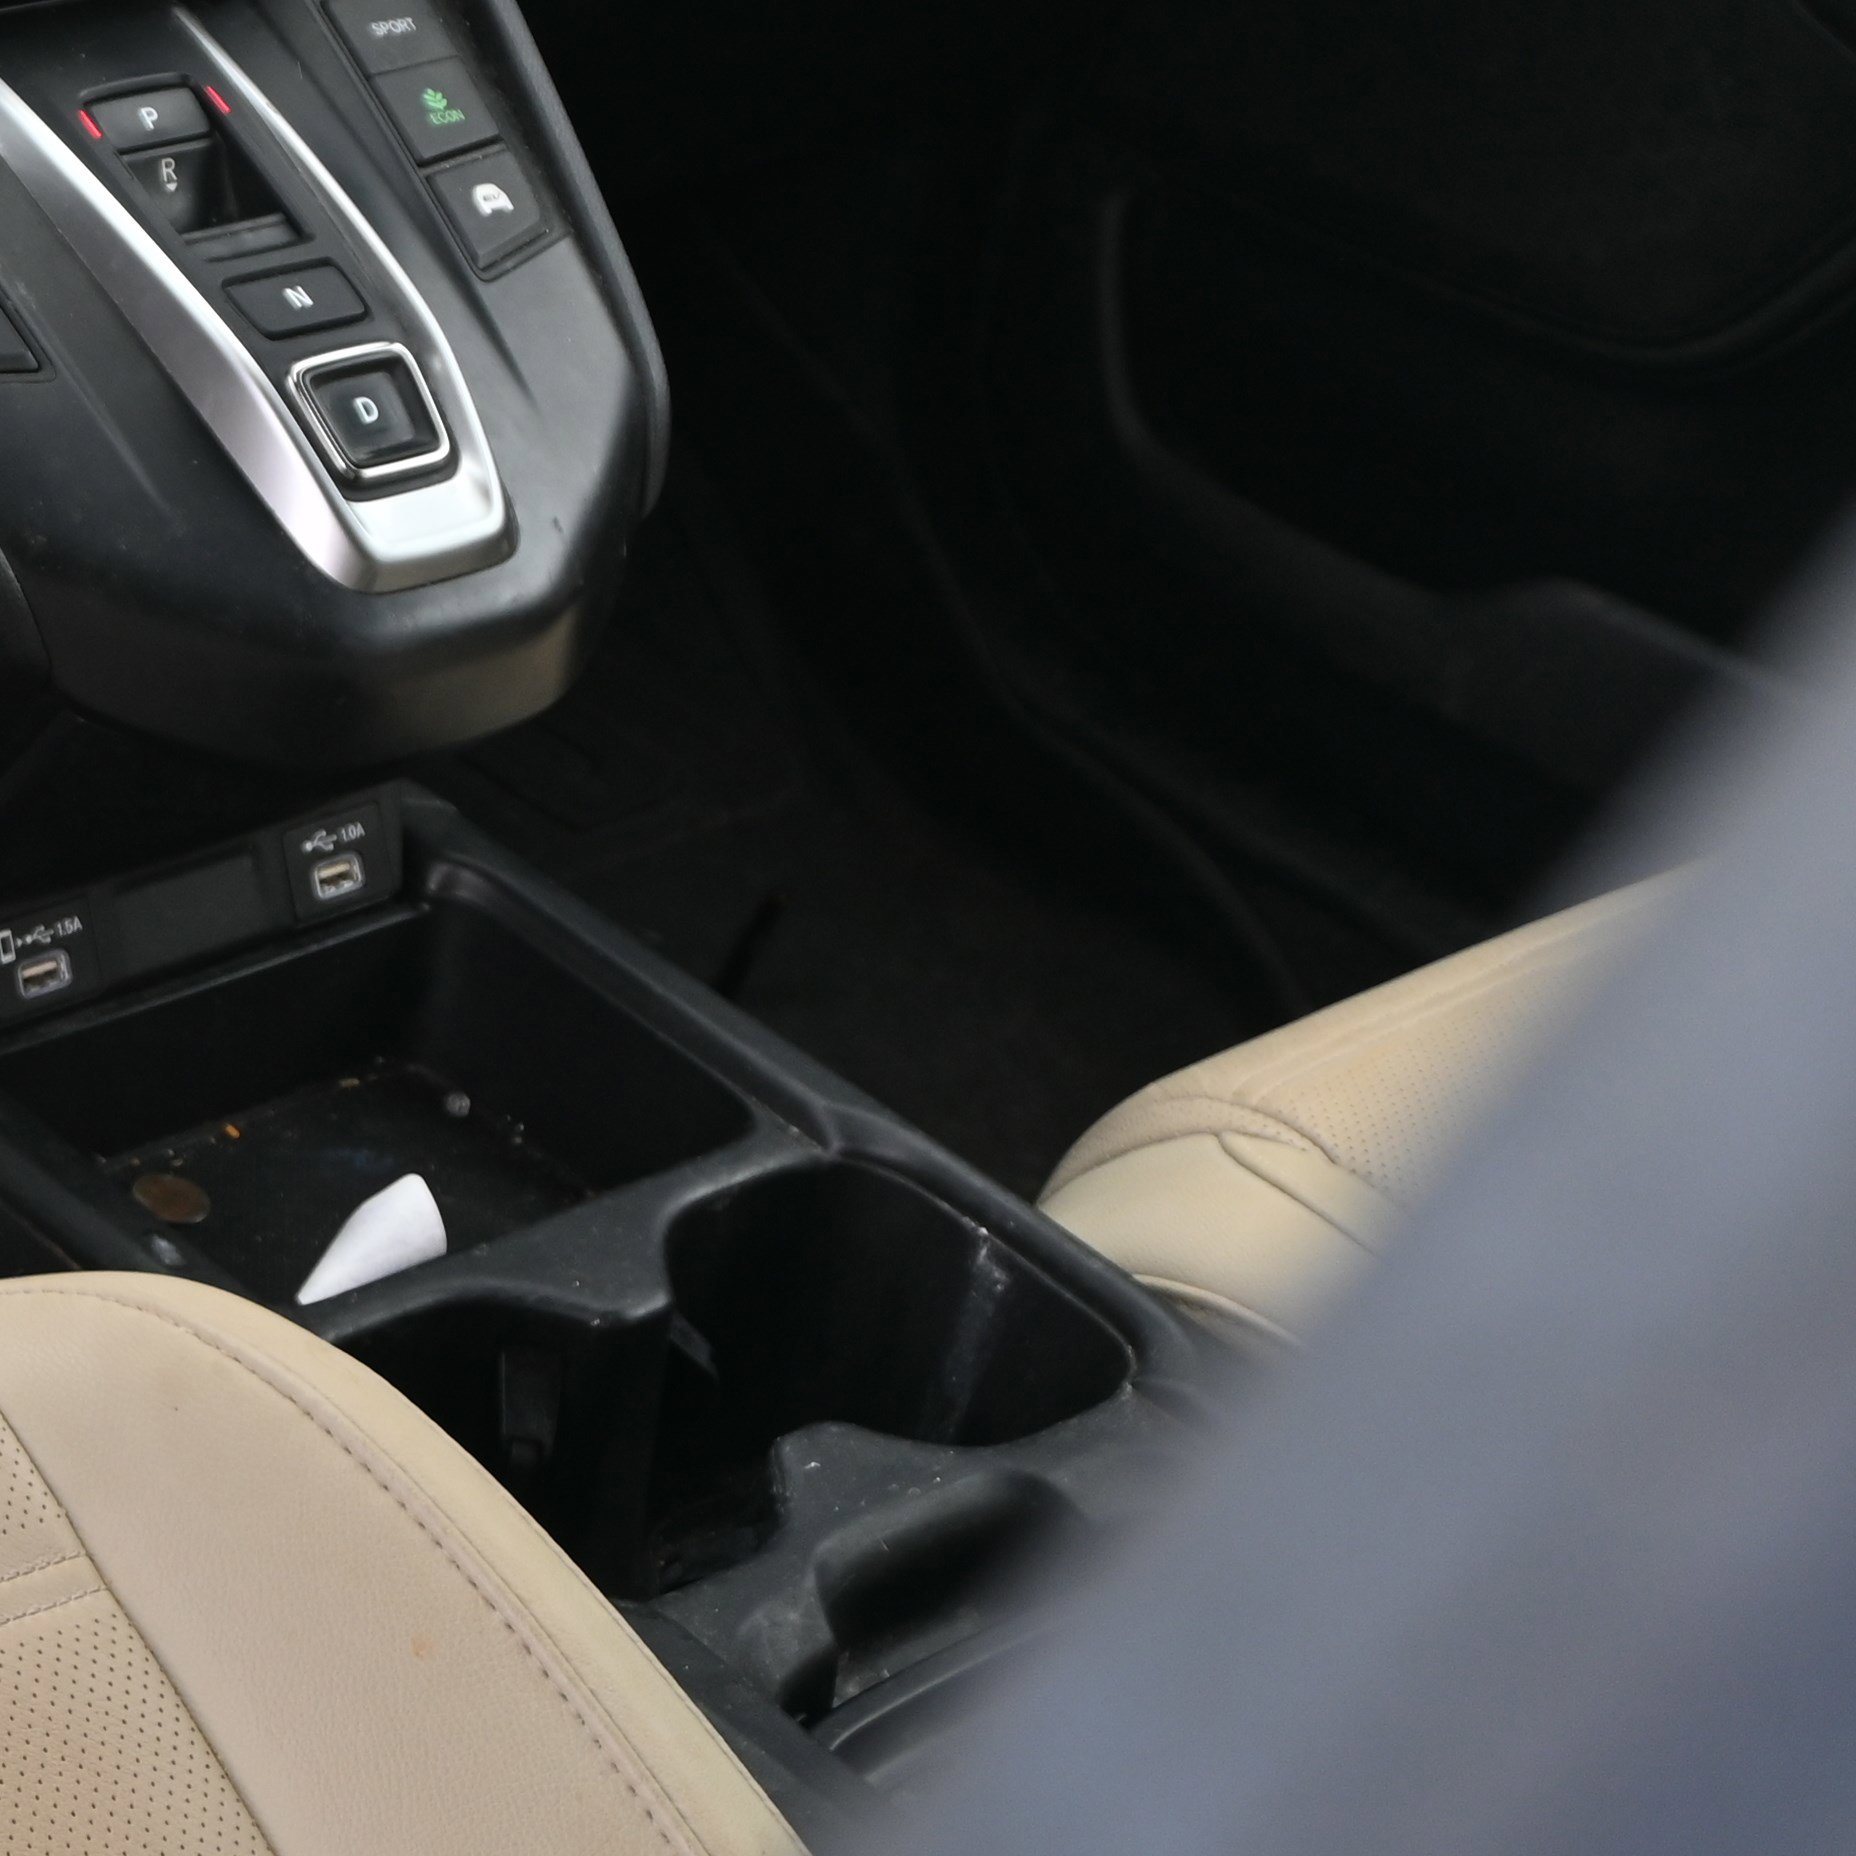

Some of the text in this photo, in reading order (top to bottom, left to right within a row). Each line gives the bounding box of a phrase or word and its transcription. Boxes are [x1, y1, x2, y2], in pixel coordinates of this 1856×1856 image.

[369, 16, 417, 37] SPORT
[138, 105, 159, 131] P
[428, 108, 466, 126] ECON
[160, 156, 178, 182] R
[281, 284, 315, 310] N
[352, 395, 380, 424] D
